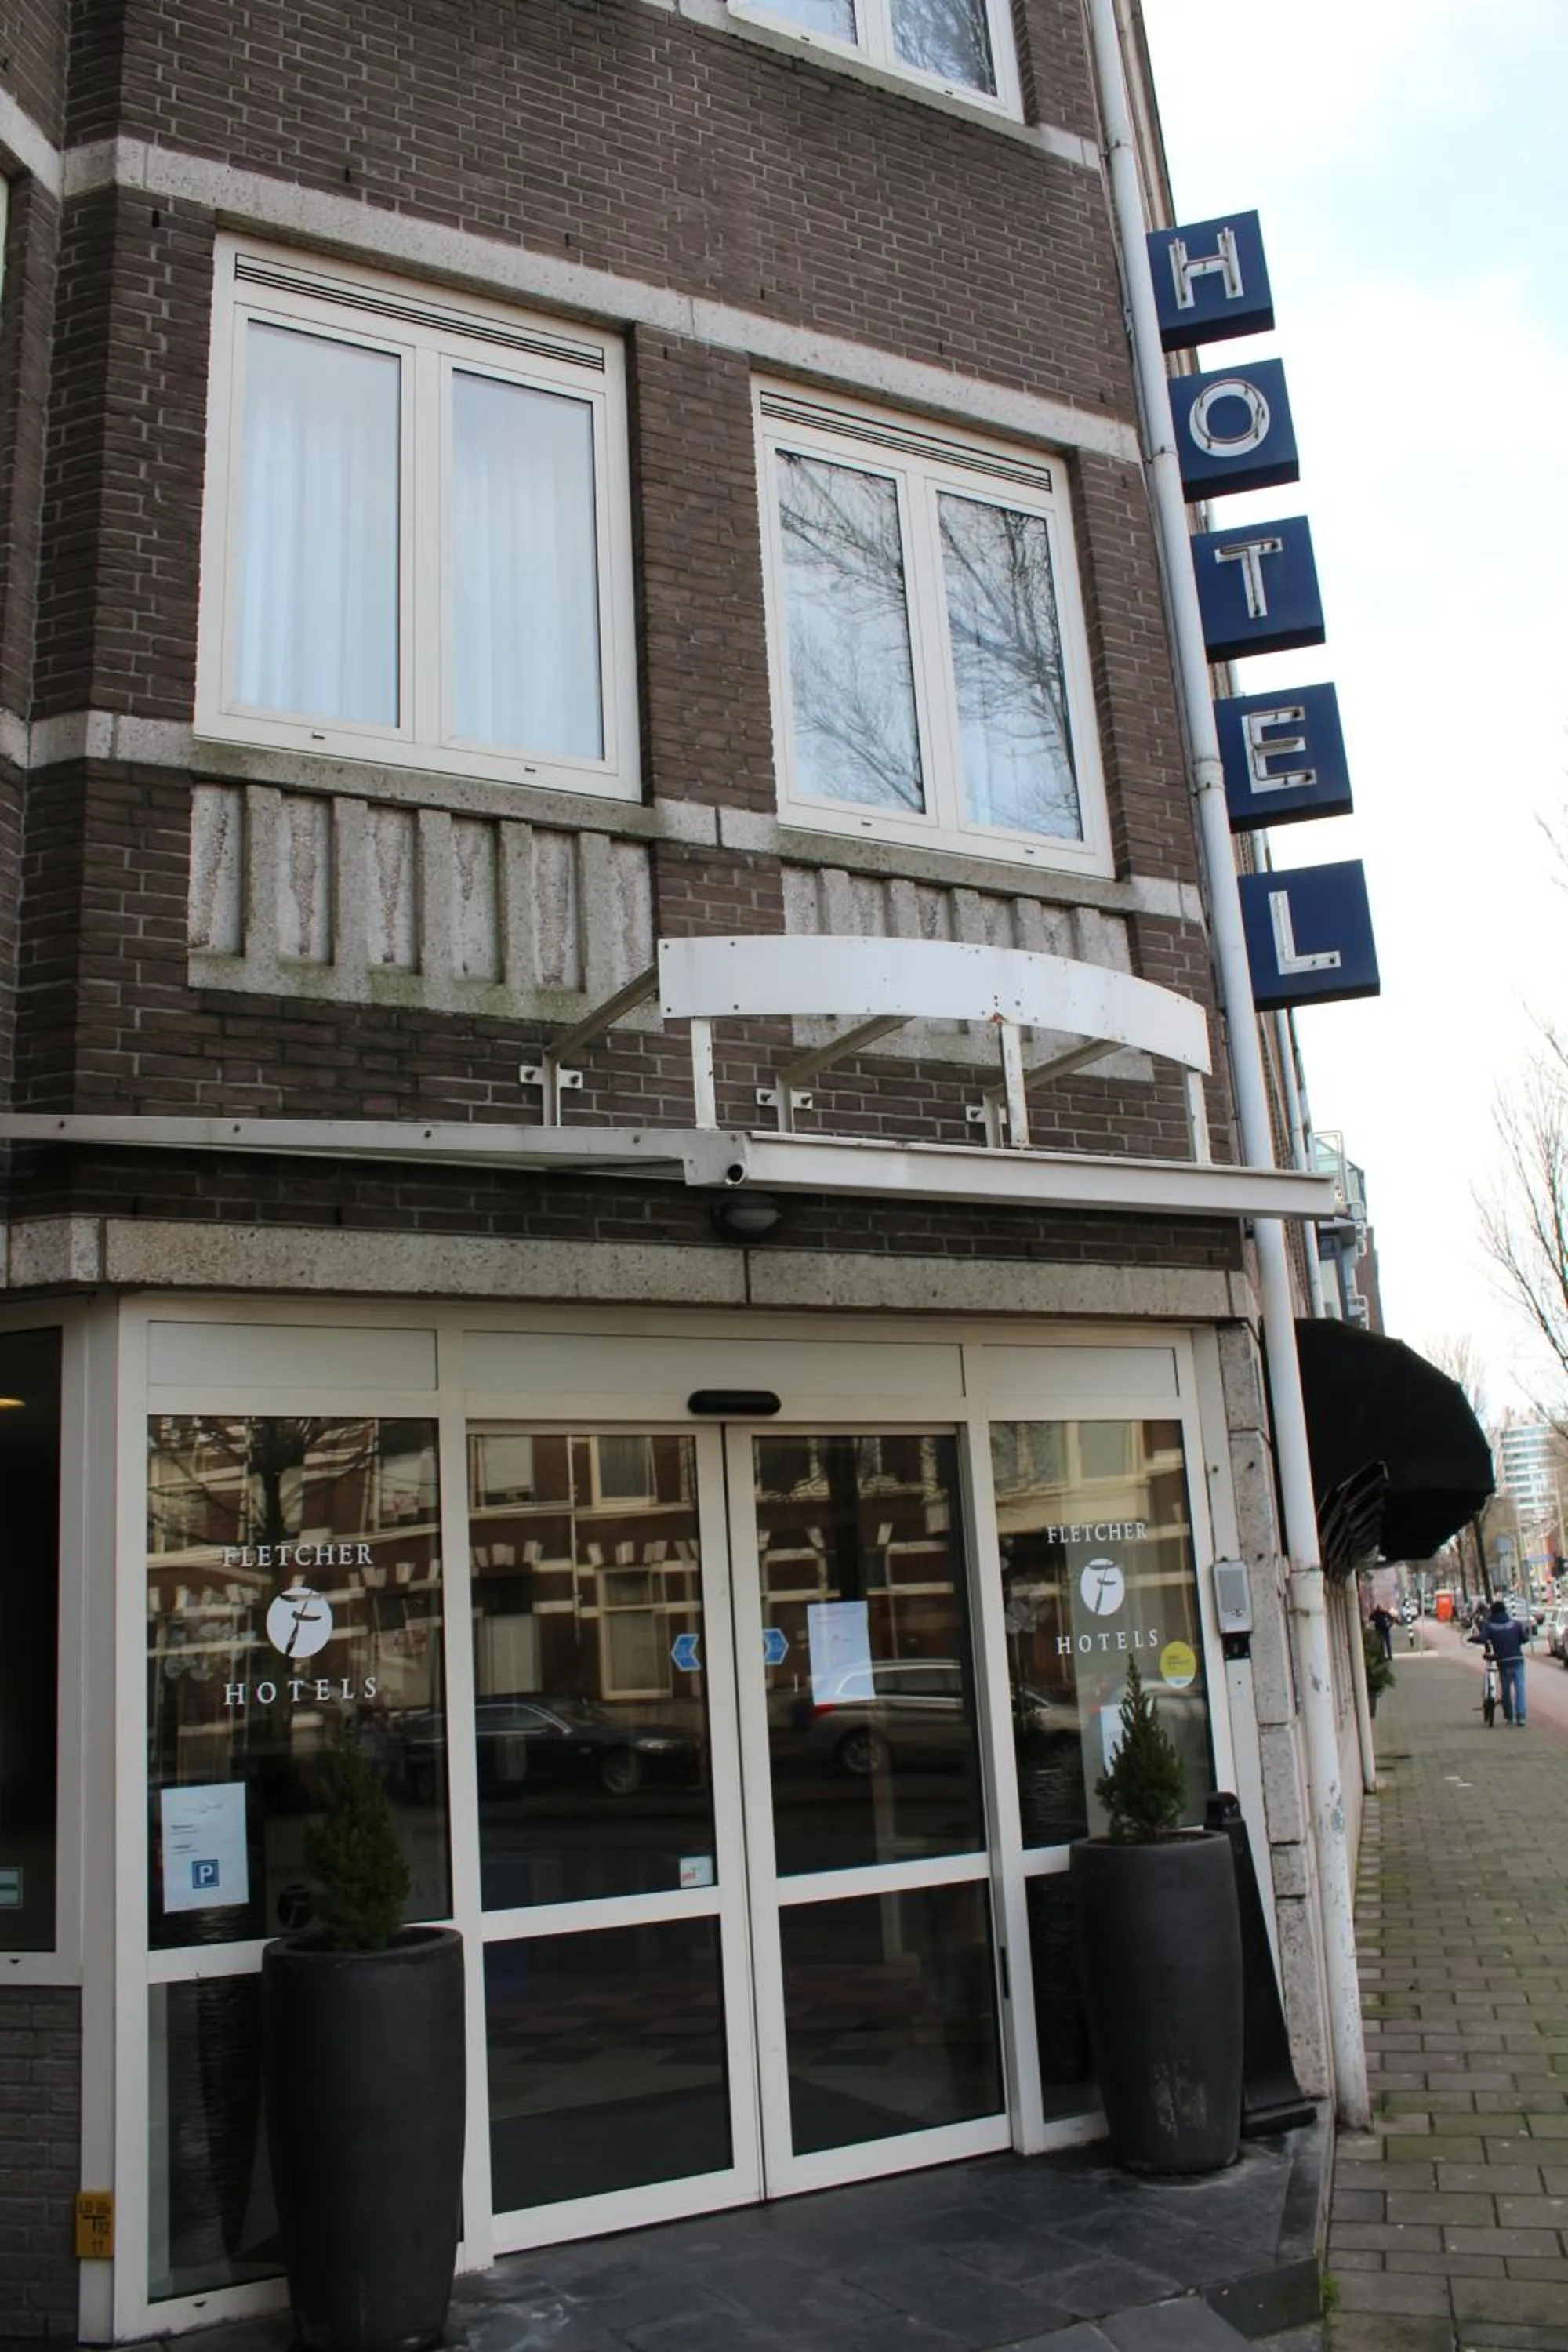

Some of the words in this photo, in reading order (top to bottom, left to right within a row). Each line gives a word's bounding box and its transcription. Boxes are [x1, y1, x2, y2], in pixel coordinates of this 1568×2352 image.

[1169, 227, 1340, 975] HOTEL
[1047, 1522, 1149, 1544] FLETCHER
[222, 1543, 374, 1568] FLETCHER
[1056, 1628, 1159, 1655] HOTELS
[223, 1676, 378, 1706] HOTELS
[199, 1864, 214, 1884] P
